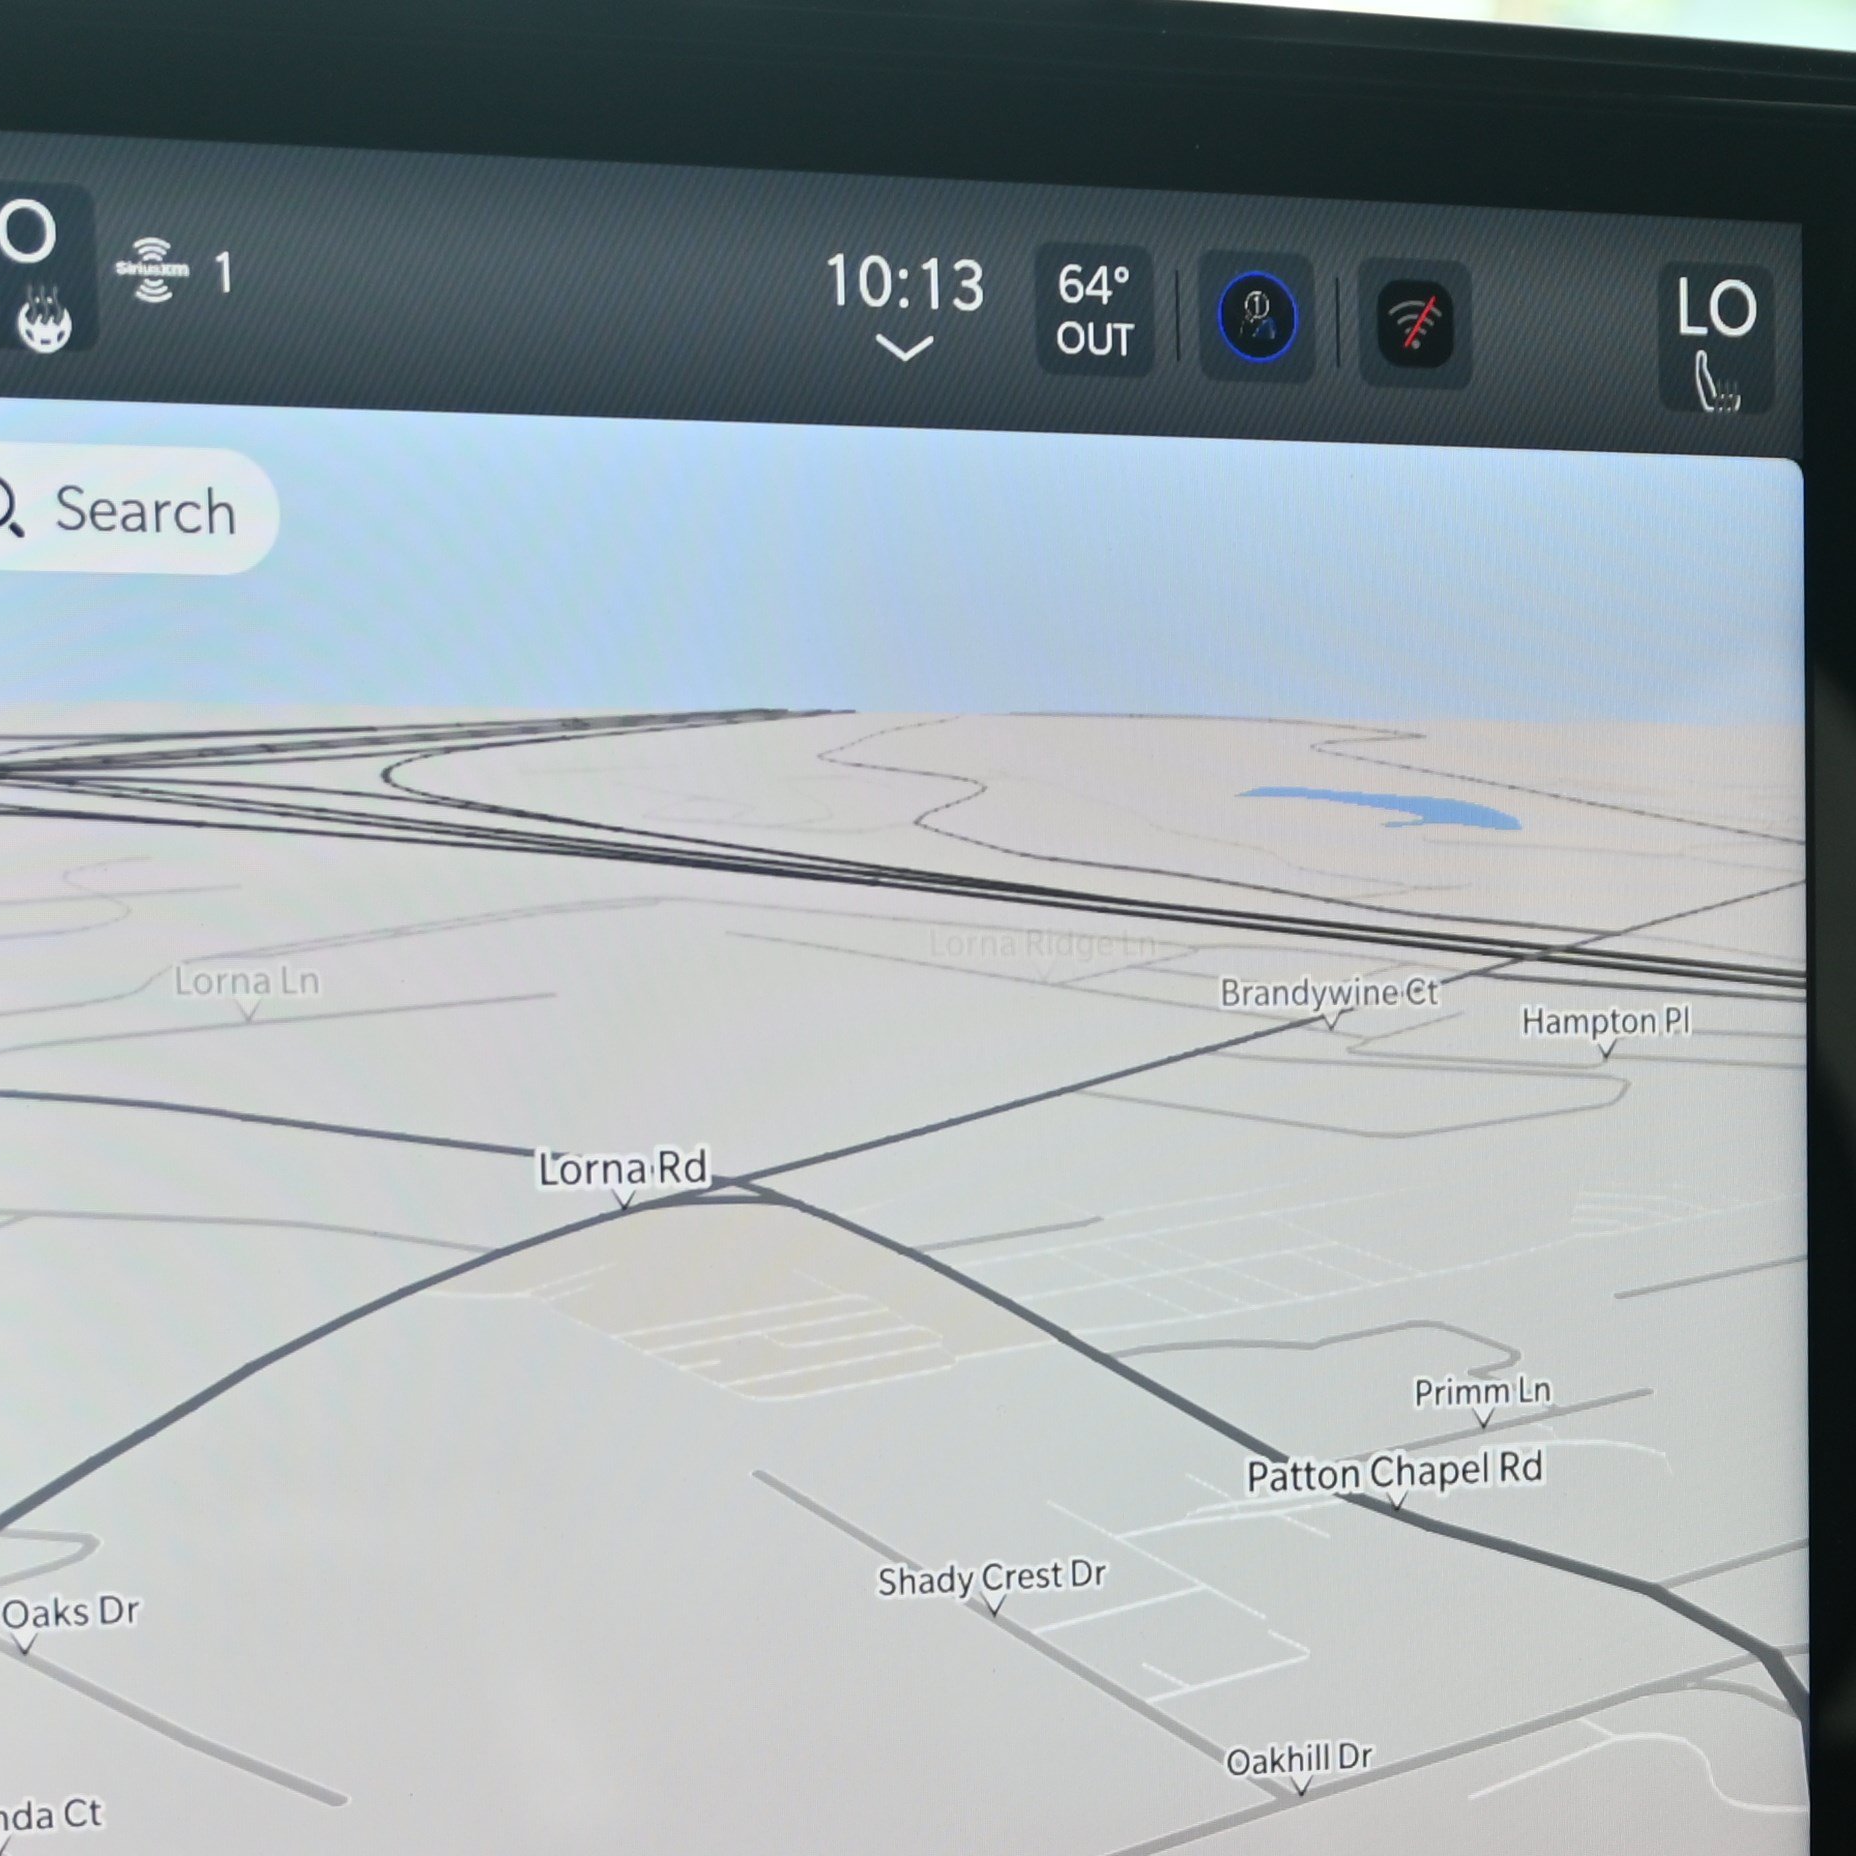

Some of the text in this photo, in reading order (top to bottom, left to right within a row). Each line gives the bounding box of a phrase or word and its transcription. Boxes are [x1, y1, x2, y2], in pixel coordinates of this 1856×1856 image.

[215, 250, 231, 293] 1
[827, 253, 985, 312] 10:13
[1057, 263, 1131, 307] 64°
[1678, 277, 1758, 338] LO
[1056, 320, 1136, 358] OUT
[56, 484, 237, 537] Search
[175, 965, 320, 997] Lorna Ln
[1220, 978, 1438, 1014] Brandywine Ct
[1521, 1006, 1691, 1042] Hampton Pl
[539, 1149, 708, 1187] Lorna Rd
[1414, 1376, 1552, 1408] Primm Ln
[1246, 1450, 1544, 1497] Patton Chapel Rd
[877, 1559, 1107, 1602] Shady Crest Dr
[2, 1597, 89, 1631] Oaks
[99, 1595, 140, 1627] Dr
[1225, 1741, 1373, 1778] Oakhill Dr
[63, 1799, 103, 1829] Ct
